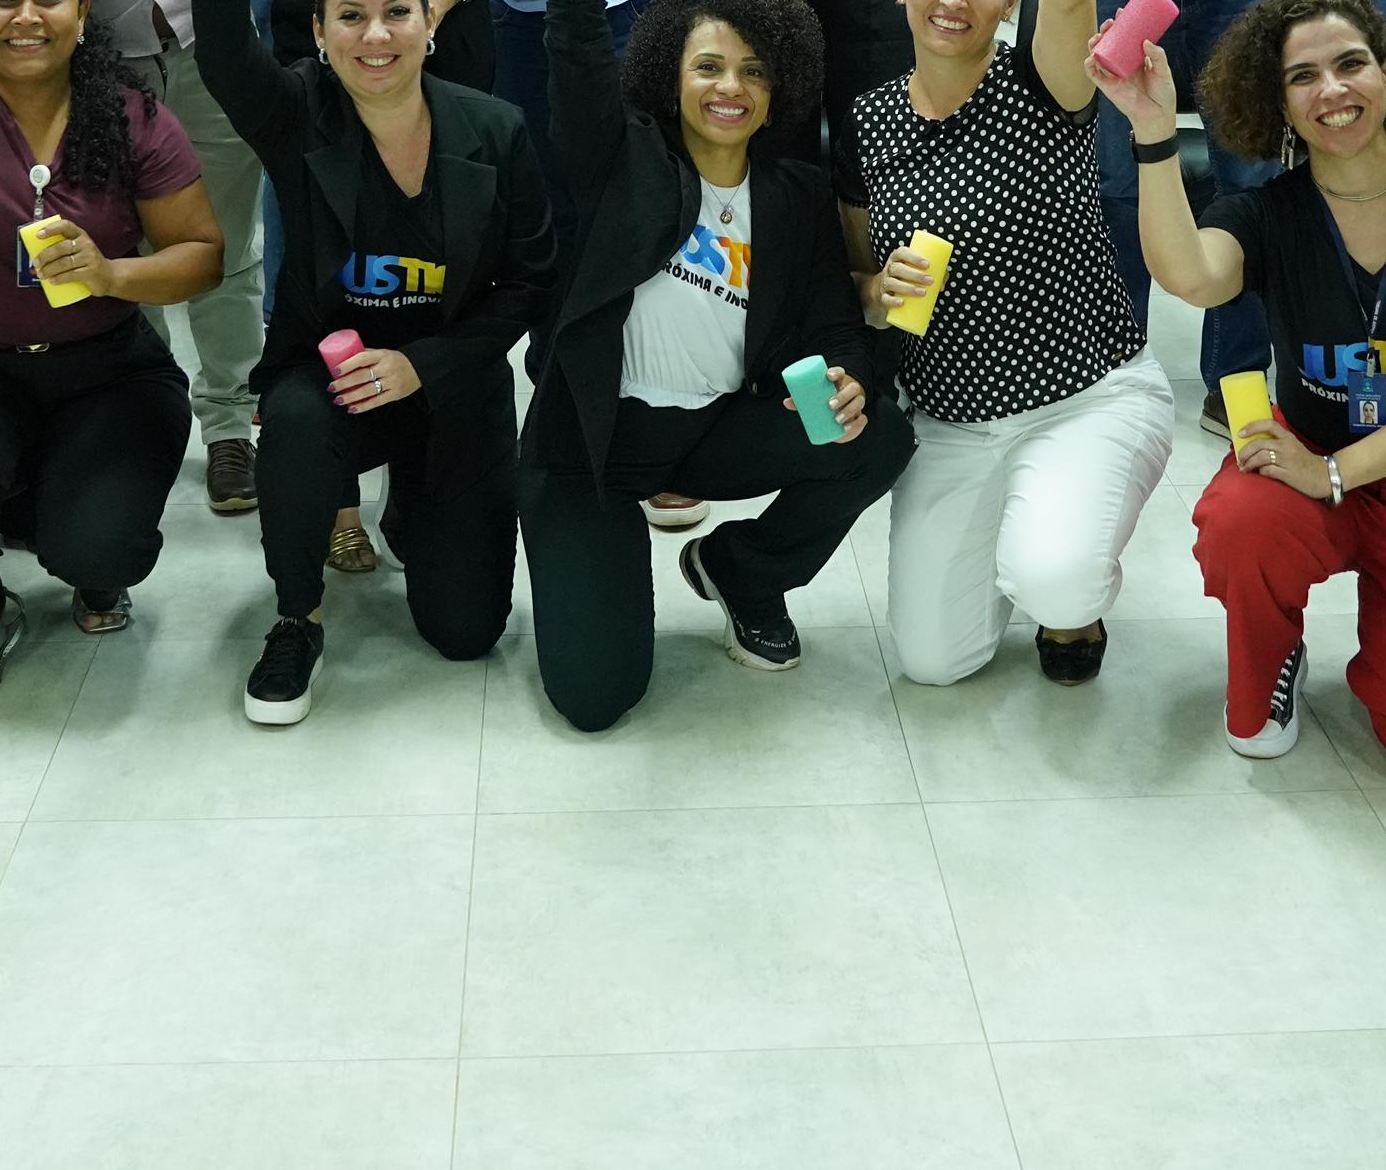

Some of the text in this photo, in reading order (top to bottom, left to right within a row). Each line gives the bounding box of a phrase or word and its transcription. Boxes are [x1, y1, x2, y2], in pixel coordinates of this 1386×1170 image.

[344, 293, 390, 308] ÓXIMA
[393, 297, 401, 308] E
[662, 260, 749, 310] RÓXIMA E INO
